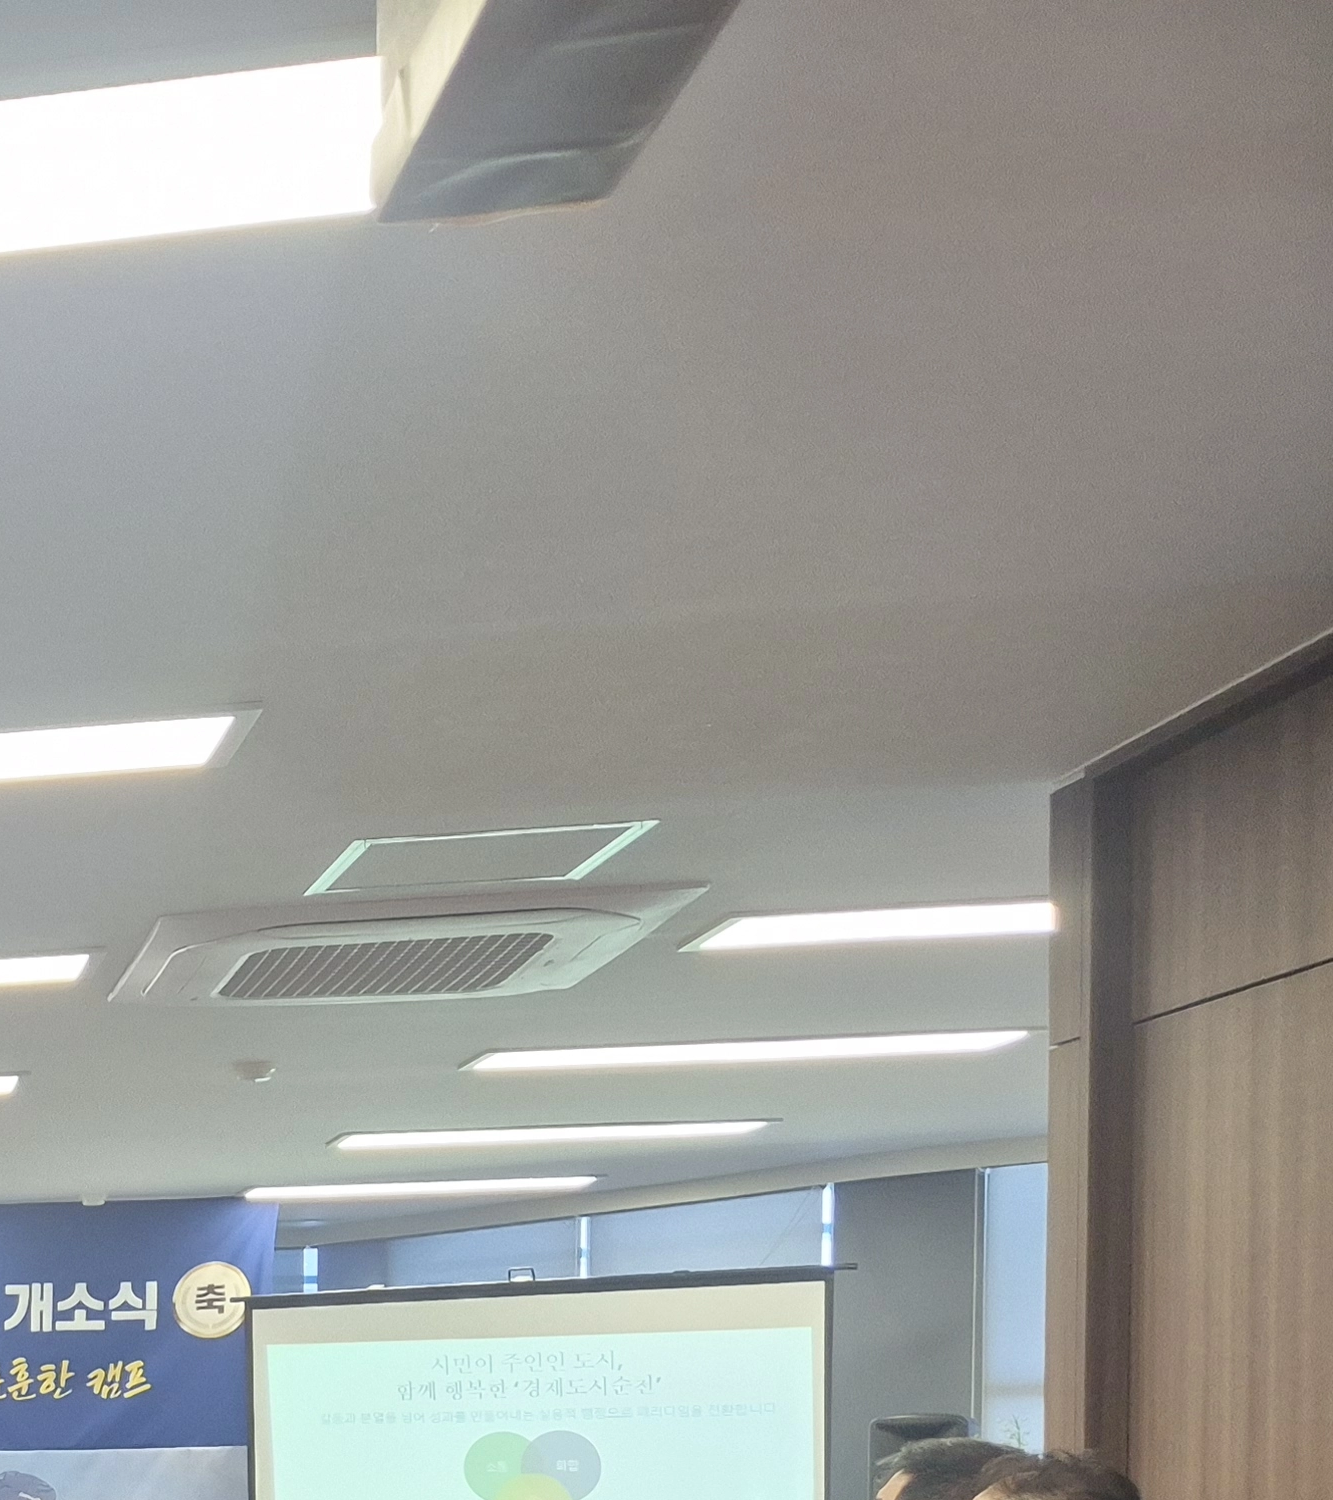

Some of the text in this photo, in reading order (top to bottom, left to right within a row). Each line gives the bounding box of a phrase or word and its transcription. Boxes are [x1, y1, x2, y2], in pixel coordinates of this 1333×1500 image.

[4, 1279, 158, 1333] 개소식
[195, 1282, 226, 1315] 축
[87, 1358, 152, 1401] 캠프
[431, 1353, 494, 1376] 시민이
[501, 1351, 565, 1374] 주인인
